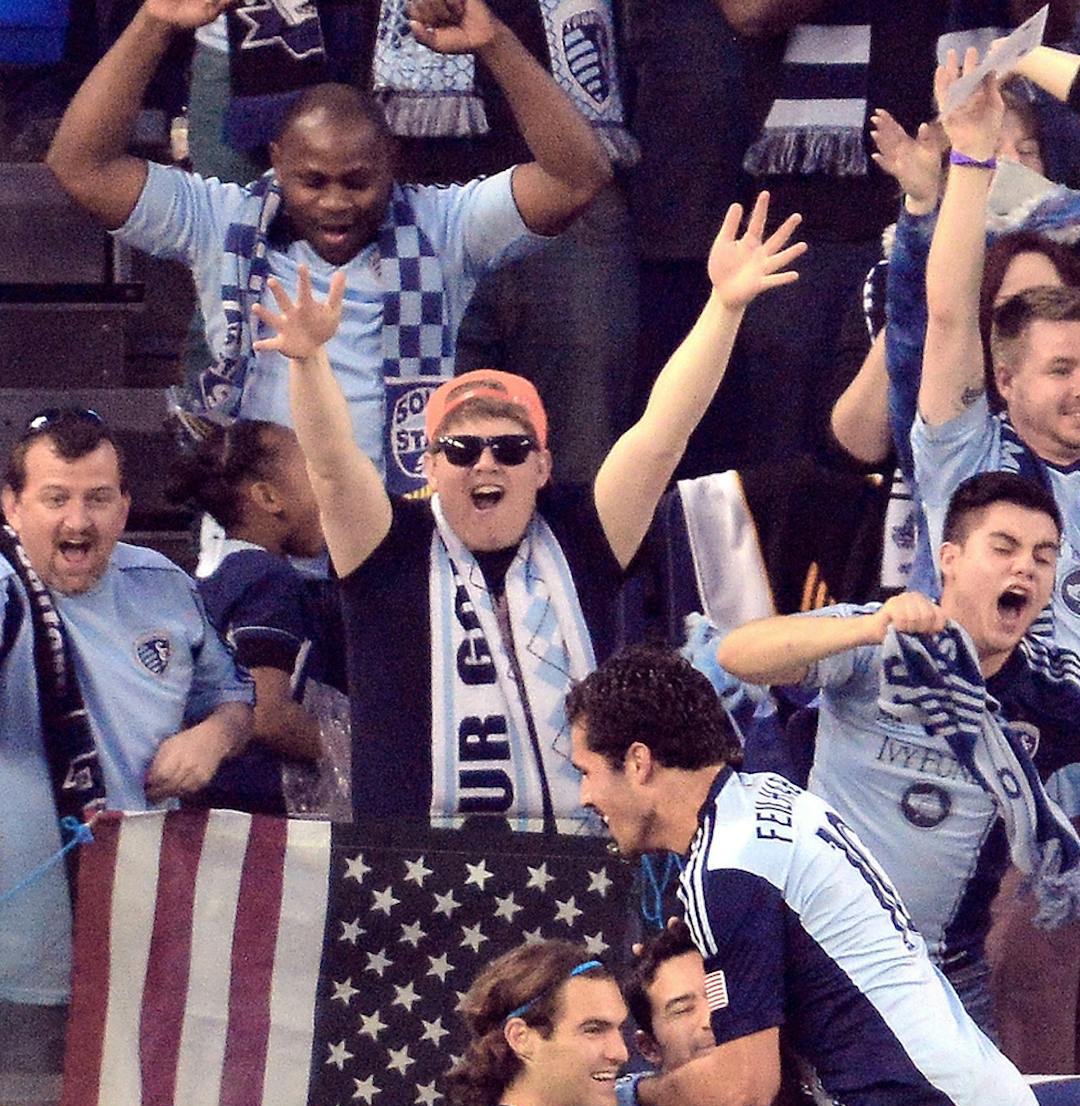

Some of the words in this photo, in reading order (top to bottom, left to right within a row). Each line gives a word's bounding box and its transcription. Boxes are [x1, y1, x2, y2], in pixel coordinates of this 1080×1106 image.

[396, 388, 430, 424] SO
[396, 429, 428, 451] ST
[459, 714, 513, 815] UR
